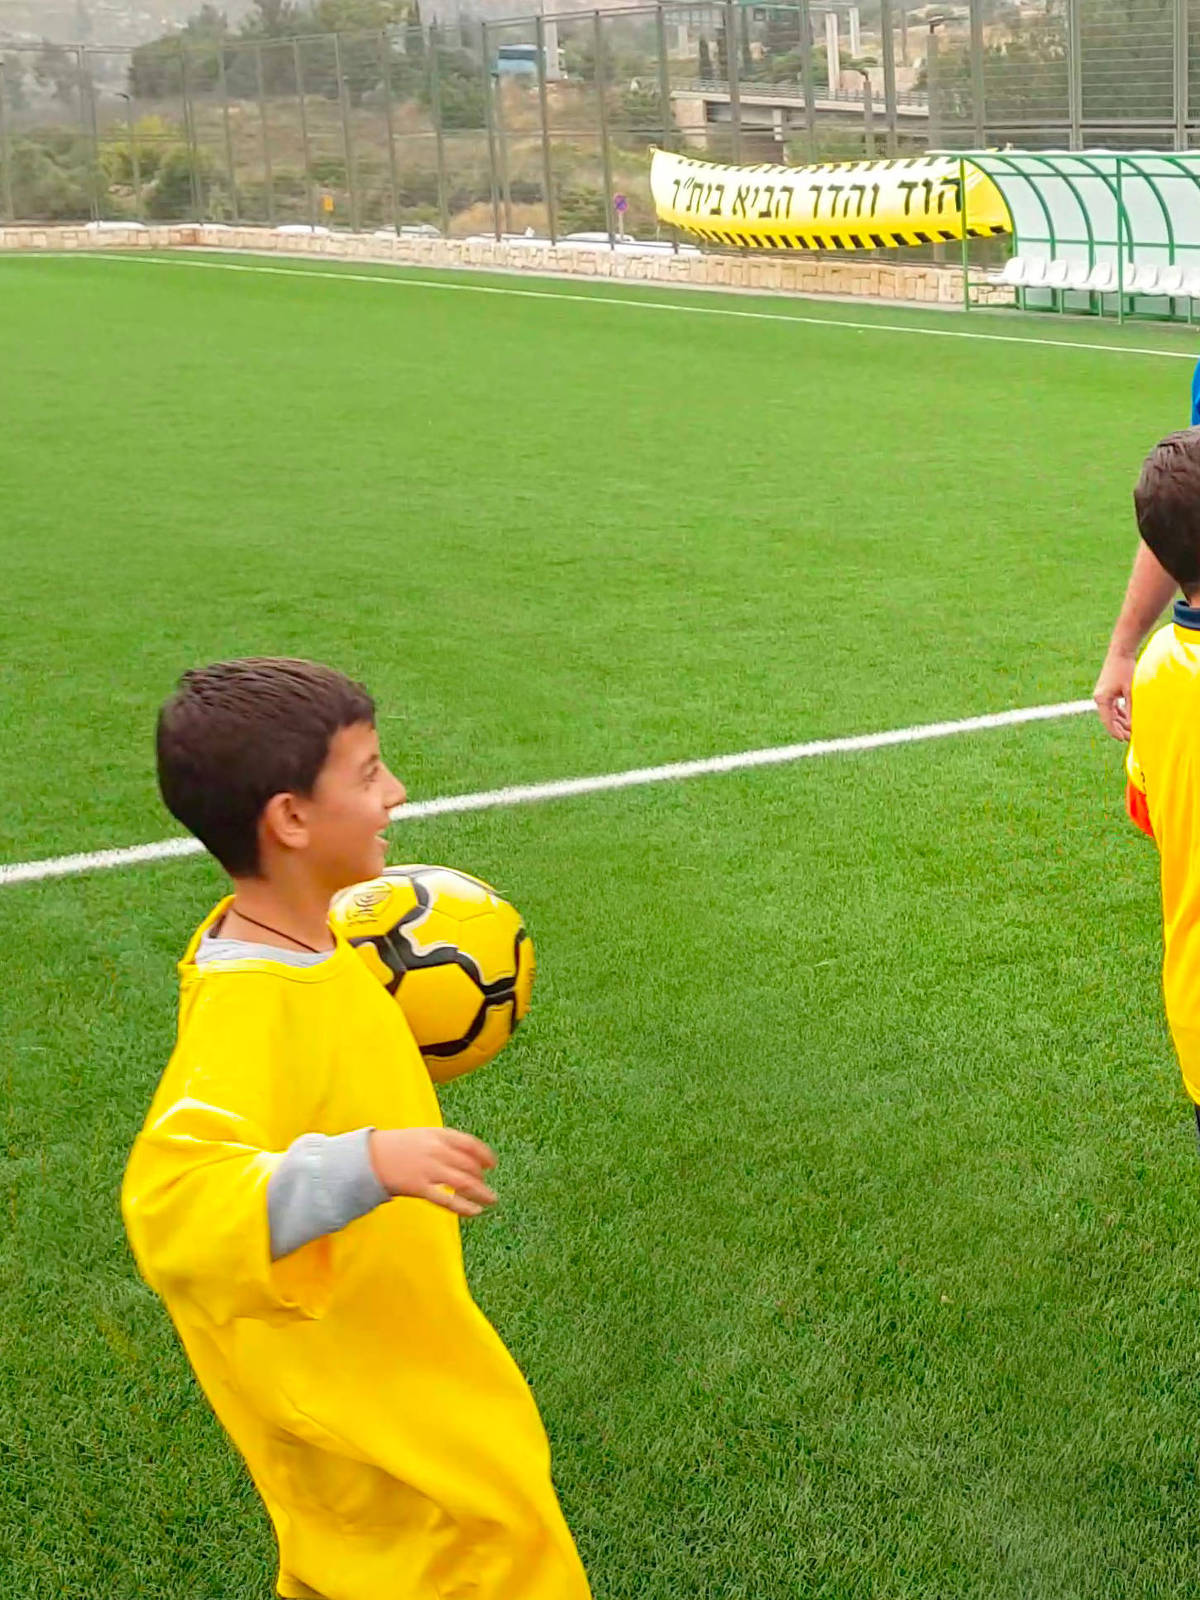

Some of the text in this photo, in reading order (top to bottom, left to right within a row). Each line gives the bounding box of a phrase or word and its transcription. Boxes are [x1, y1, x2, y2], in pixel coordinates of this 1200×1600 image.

[732, 184, 794, 219] הביא
[809, 182, 880, 218] והדר
[898, 178, 963, 216] הוד
